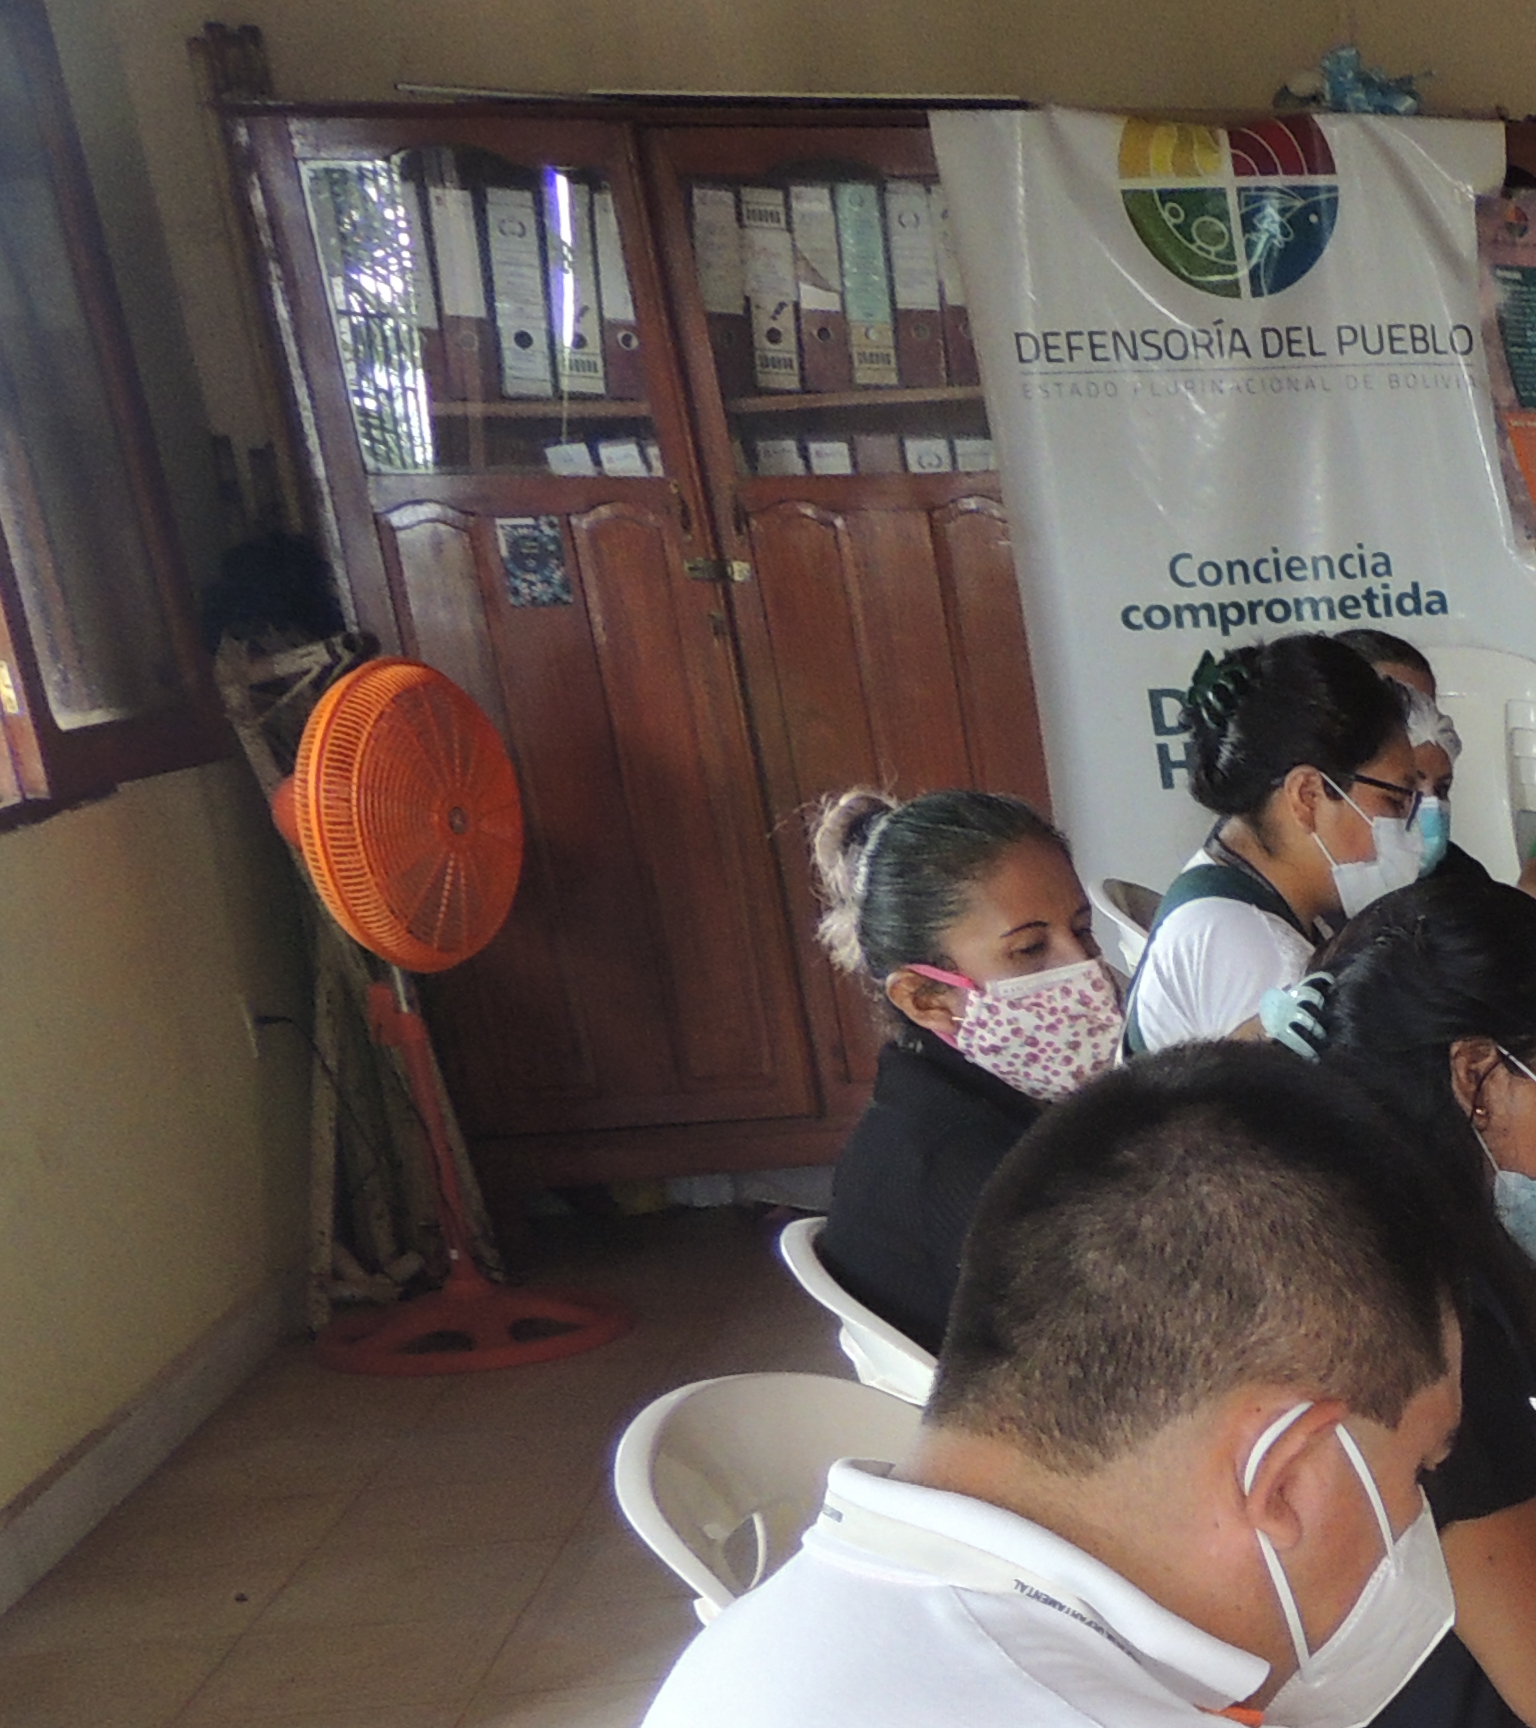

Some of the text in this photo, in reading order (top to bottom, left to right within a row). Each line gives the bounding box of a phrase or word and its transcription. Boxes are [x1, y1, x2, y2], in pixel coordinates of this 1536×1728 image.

[1014, 319, 1475, 365] DEFENSORÍA DEL PUEBLO
[1346, 374, 1375, 393] DE
[1120, 542, 1449, 637] Conciencia comprometida
